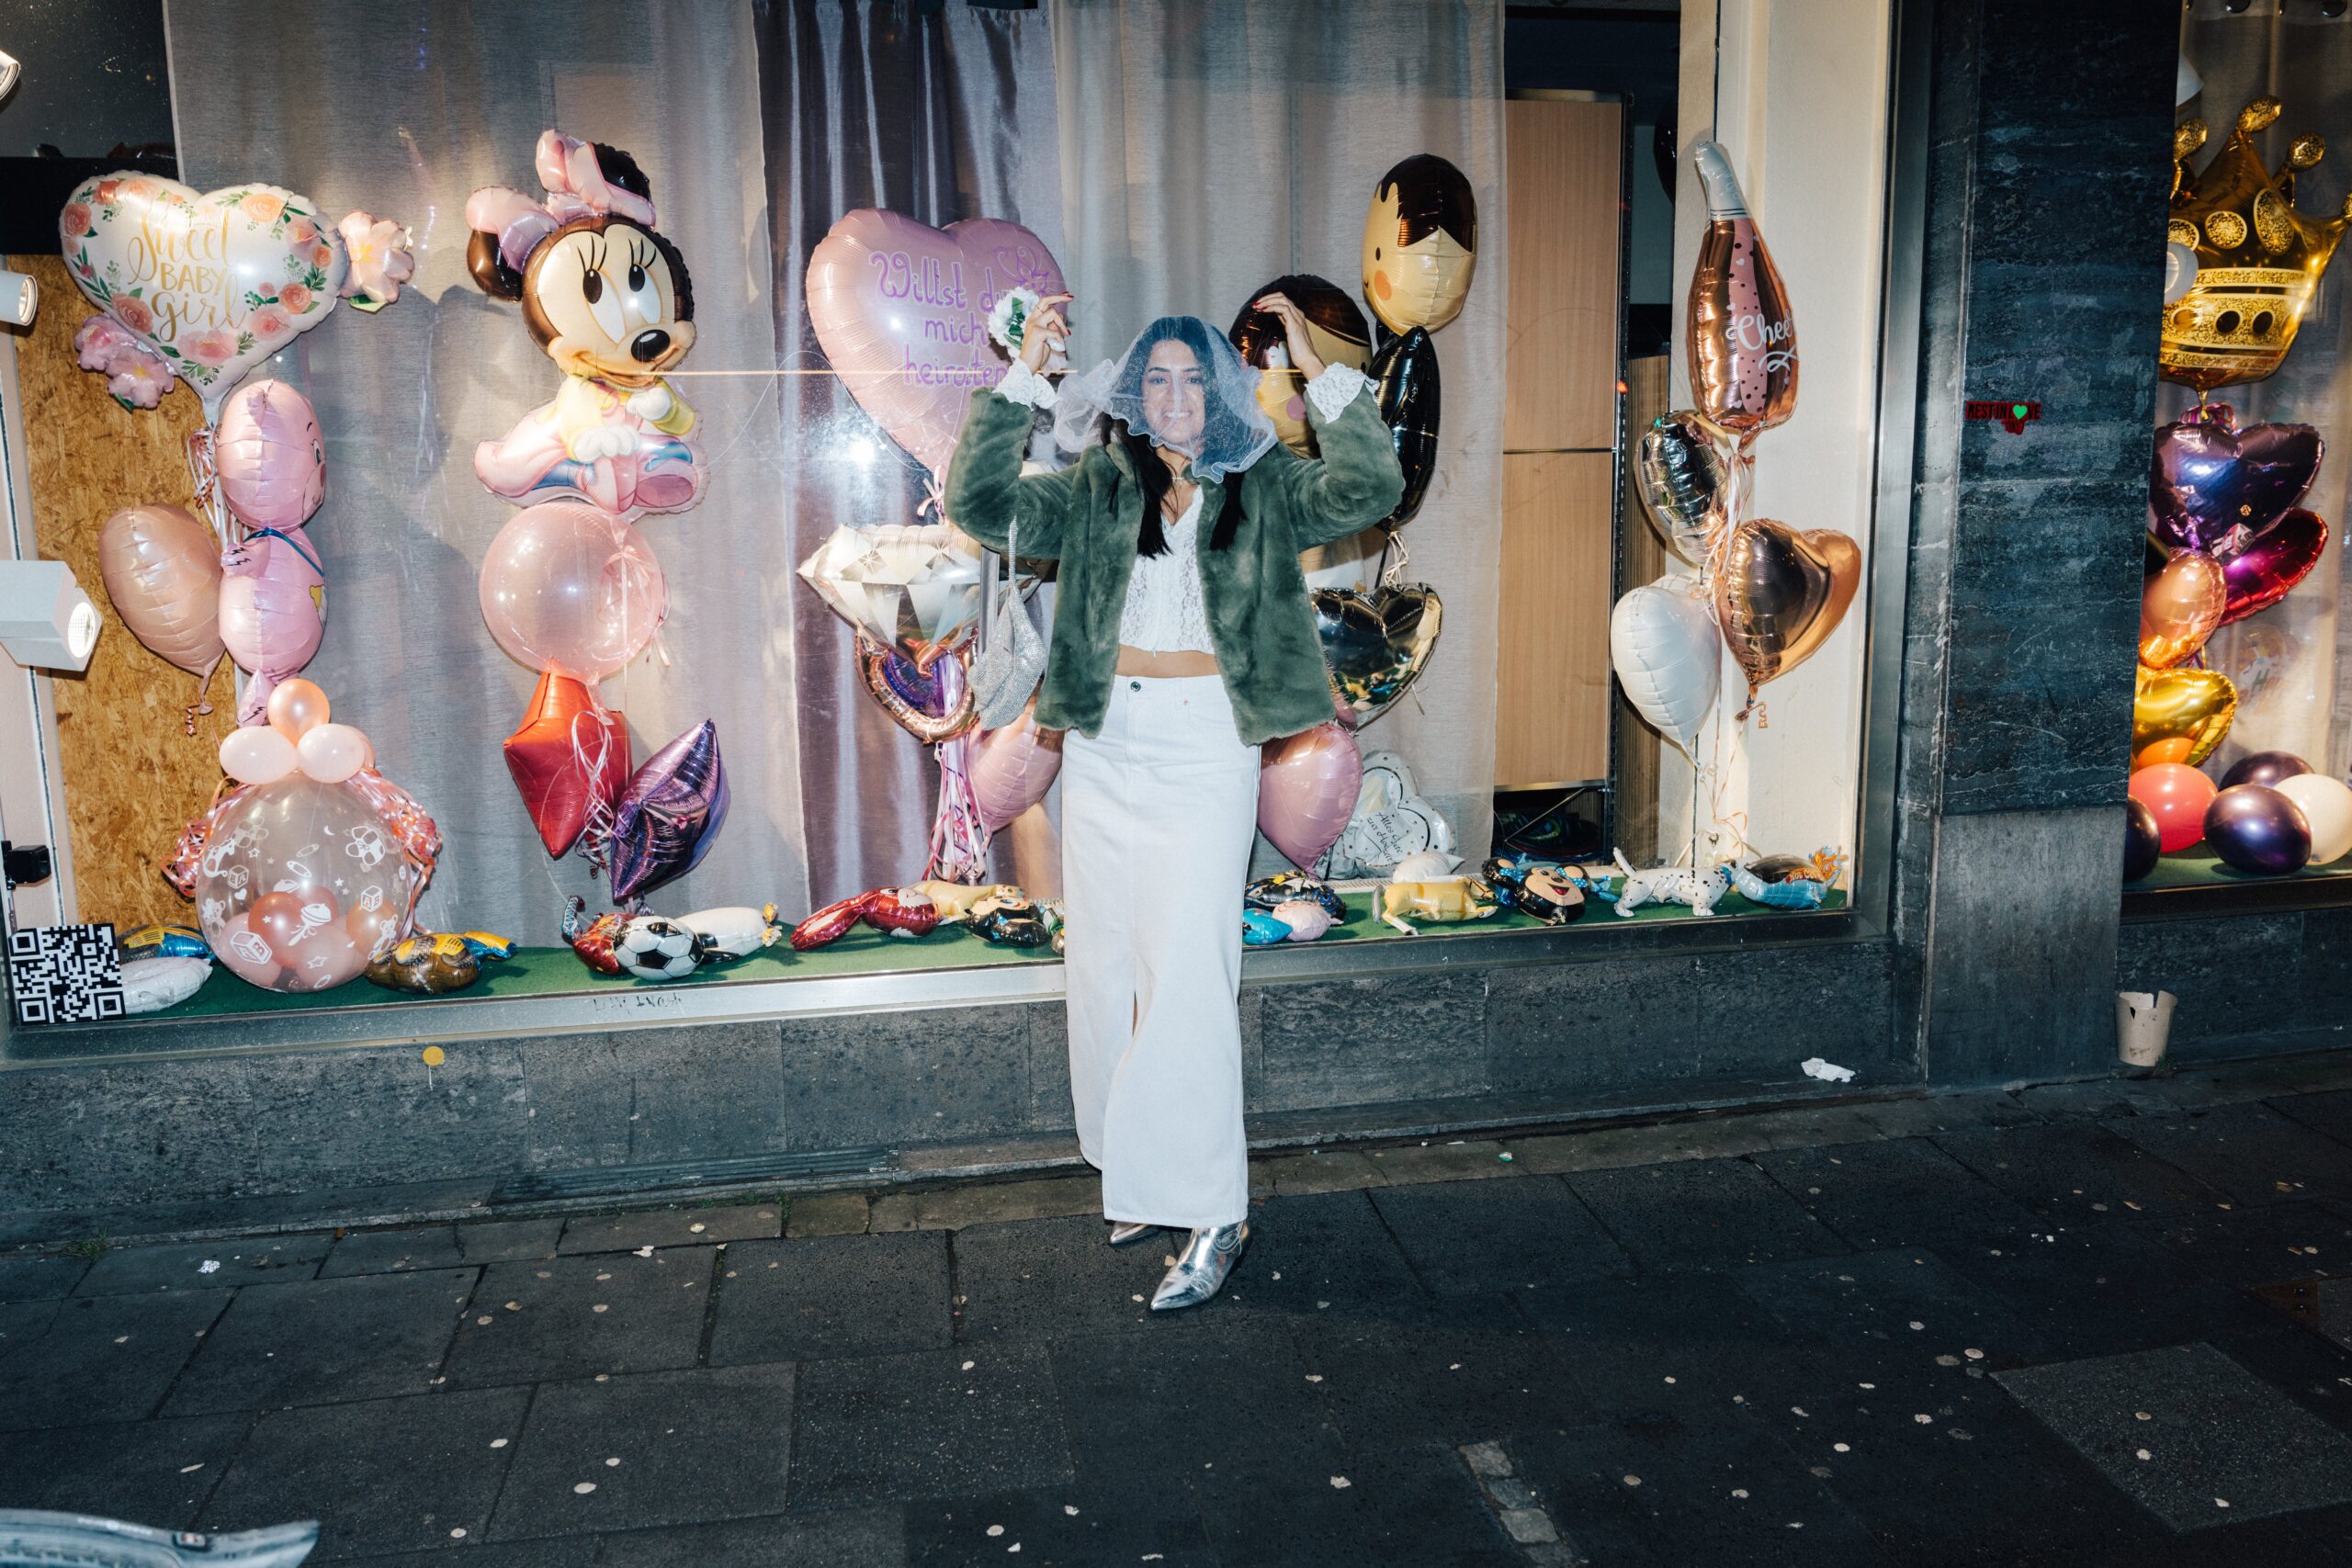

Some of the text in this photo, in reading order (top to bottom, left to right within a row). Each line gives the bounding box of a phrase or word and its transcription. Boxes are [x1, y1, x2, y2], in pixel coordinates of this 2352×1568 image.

[128, 209, 230, 285] Sweet
[160, 263, 229, 295] BABY
[869, 251, 967, 310] Willst
[152, 275, 246, 342] girl
[924, 311, 988, 346] mich
[1366, 817, 1378, 830] zur
[1375, 812, 1394, 833] Alles
